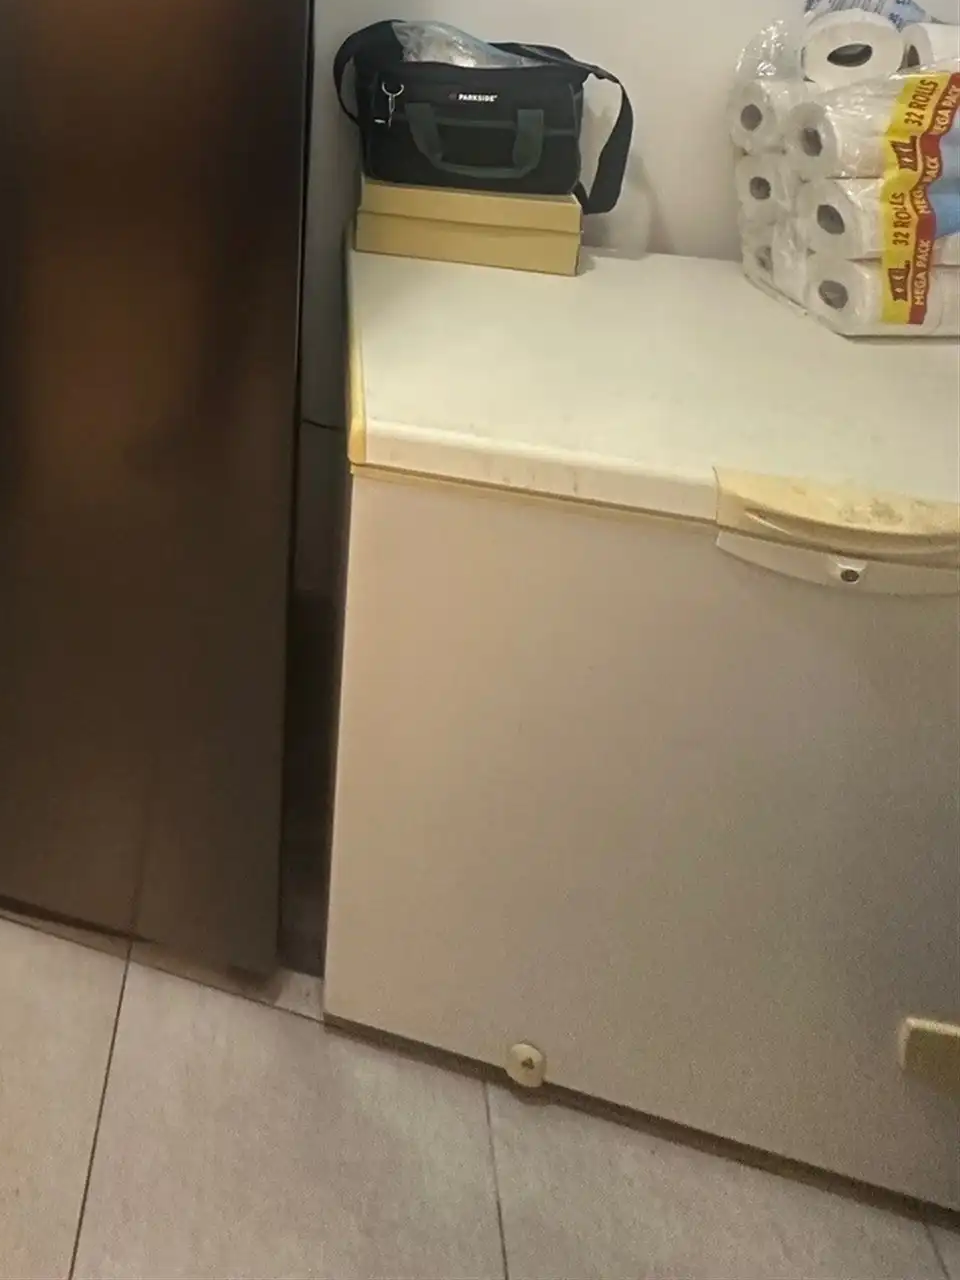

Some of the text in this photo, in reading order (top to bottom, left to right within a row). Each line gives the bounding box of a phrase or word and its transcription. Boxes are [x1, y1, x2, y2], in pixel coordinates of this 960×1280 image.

[904, 79, 939, 127] 32 ROLLS
[889, 192, 911, 247] 32 ROLLS
[913, 239, 931, 306] MEGA PACK
